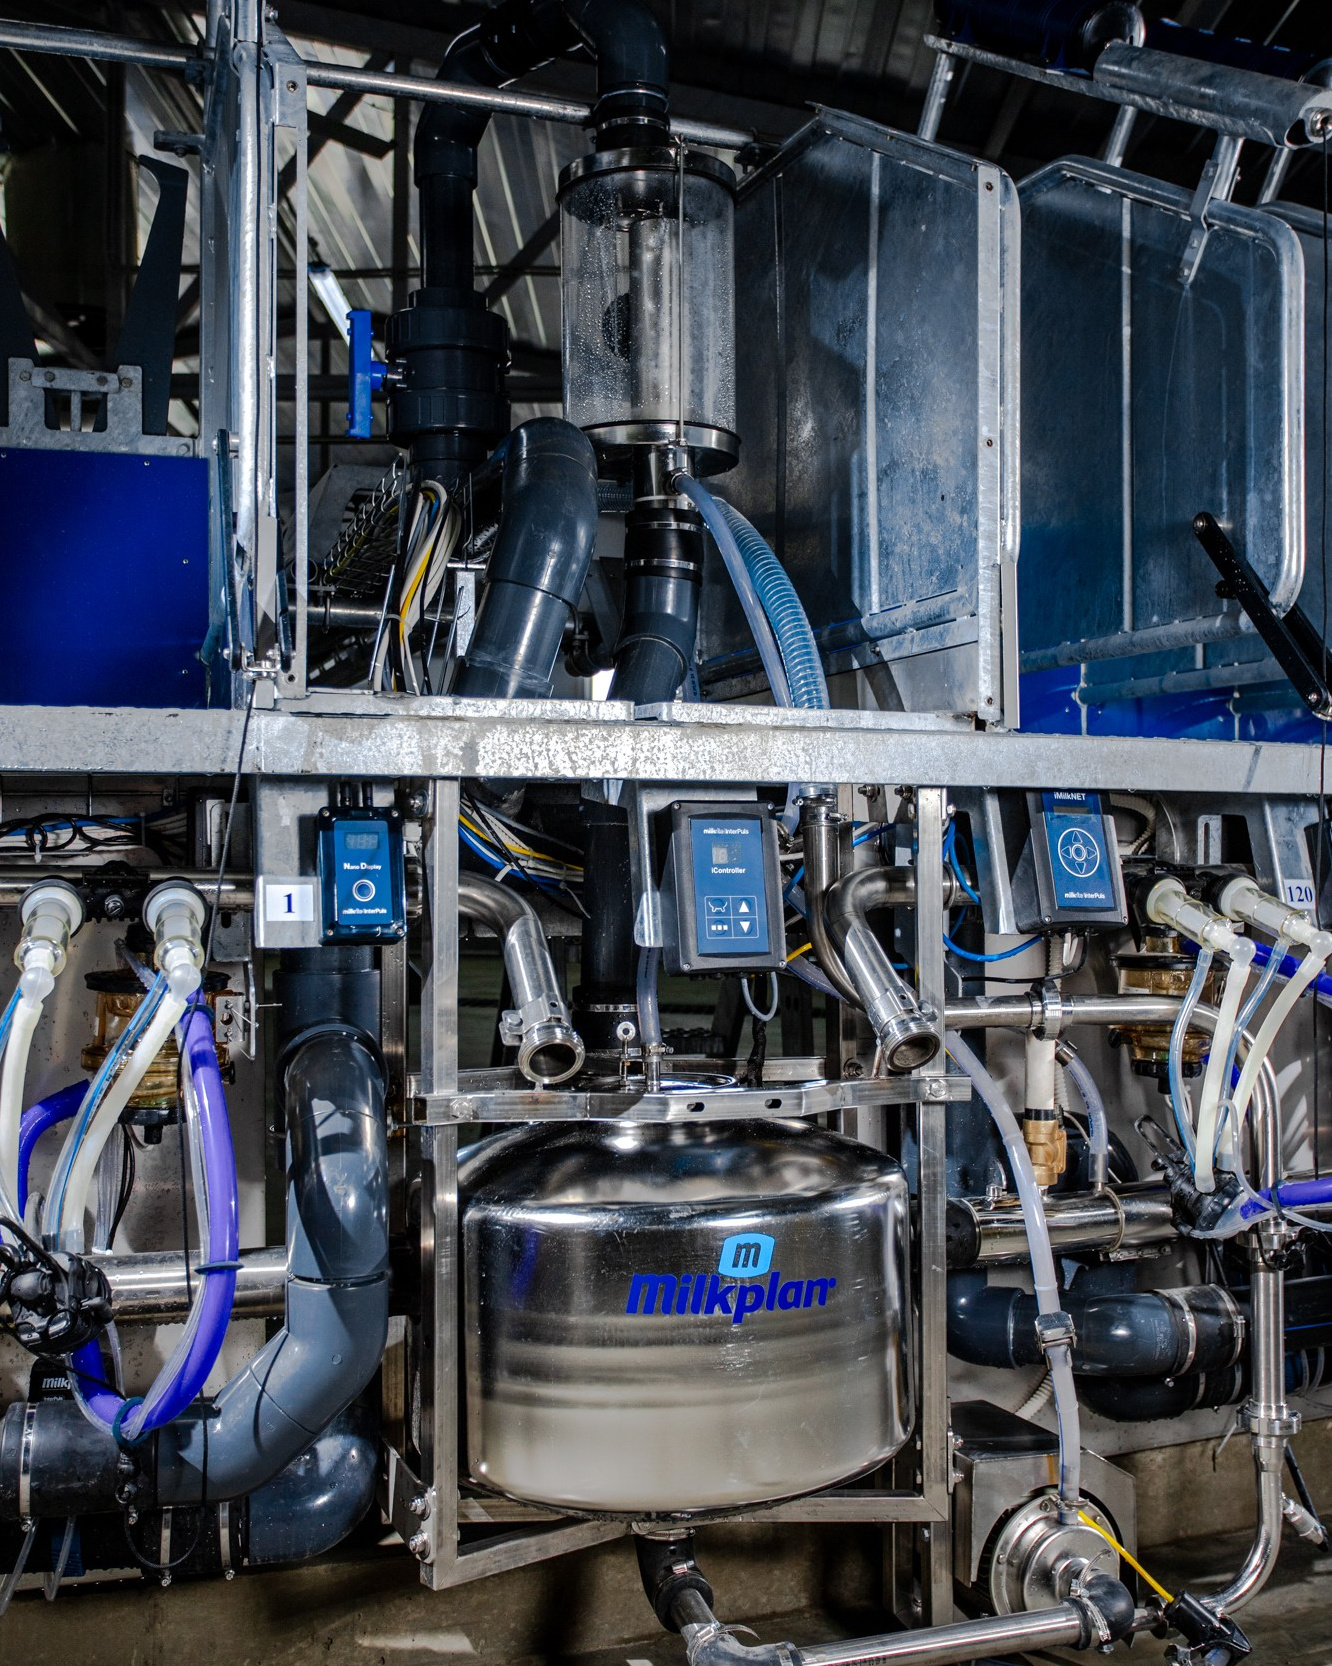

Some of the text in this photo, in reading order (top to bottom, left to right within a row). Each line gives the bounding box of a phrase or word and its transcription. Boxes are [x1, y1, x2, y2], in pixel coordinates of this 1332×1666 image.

[1053, 791, 1086, 801] iMilkNET
[343, 862, 382, 871] Nano Display
[711, 866, 746, 874] iController
[1288, 886, 1313, 903] 120
[283, 893, 296, 914] 1
